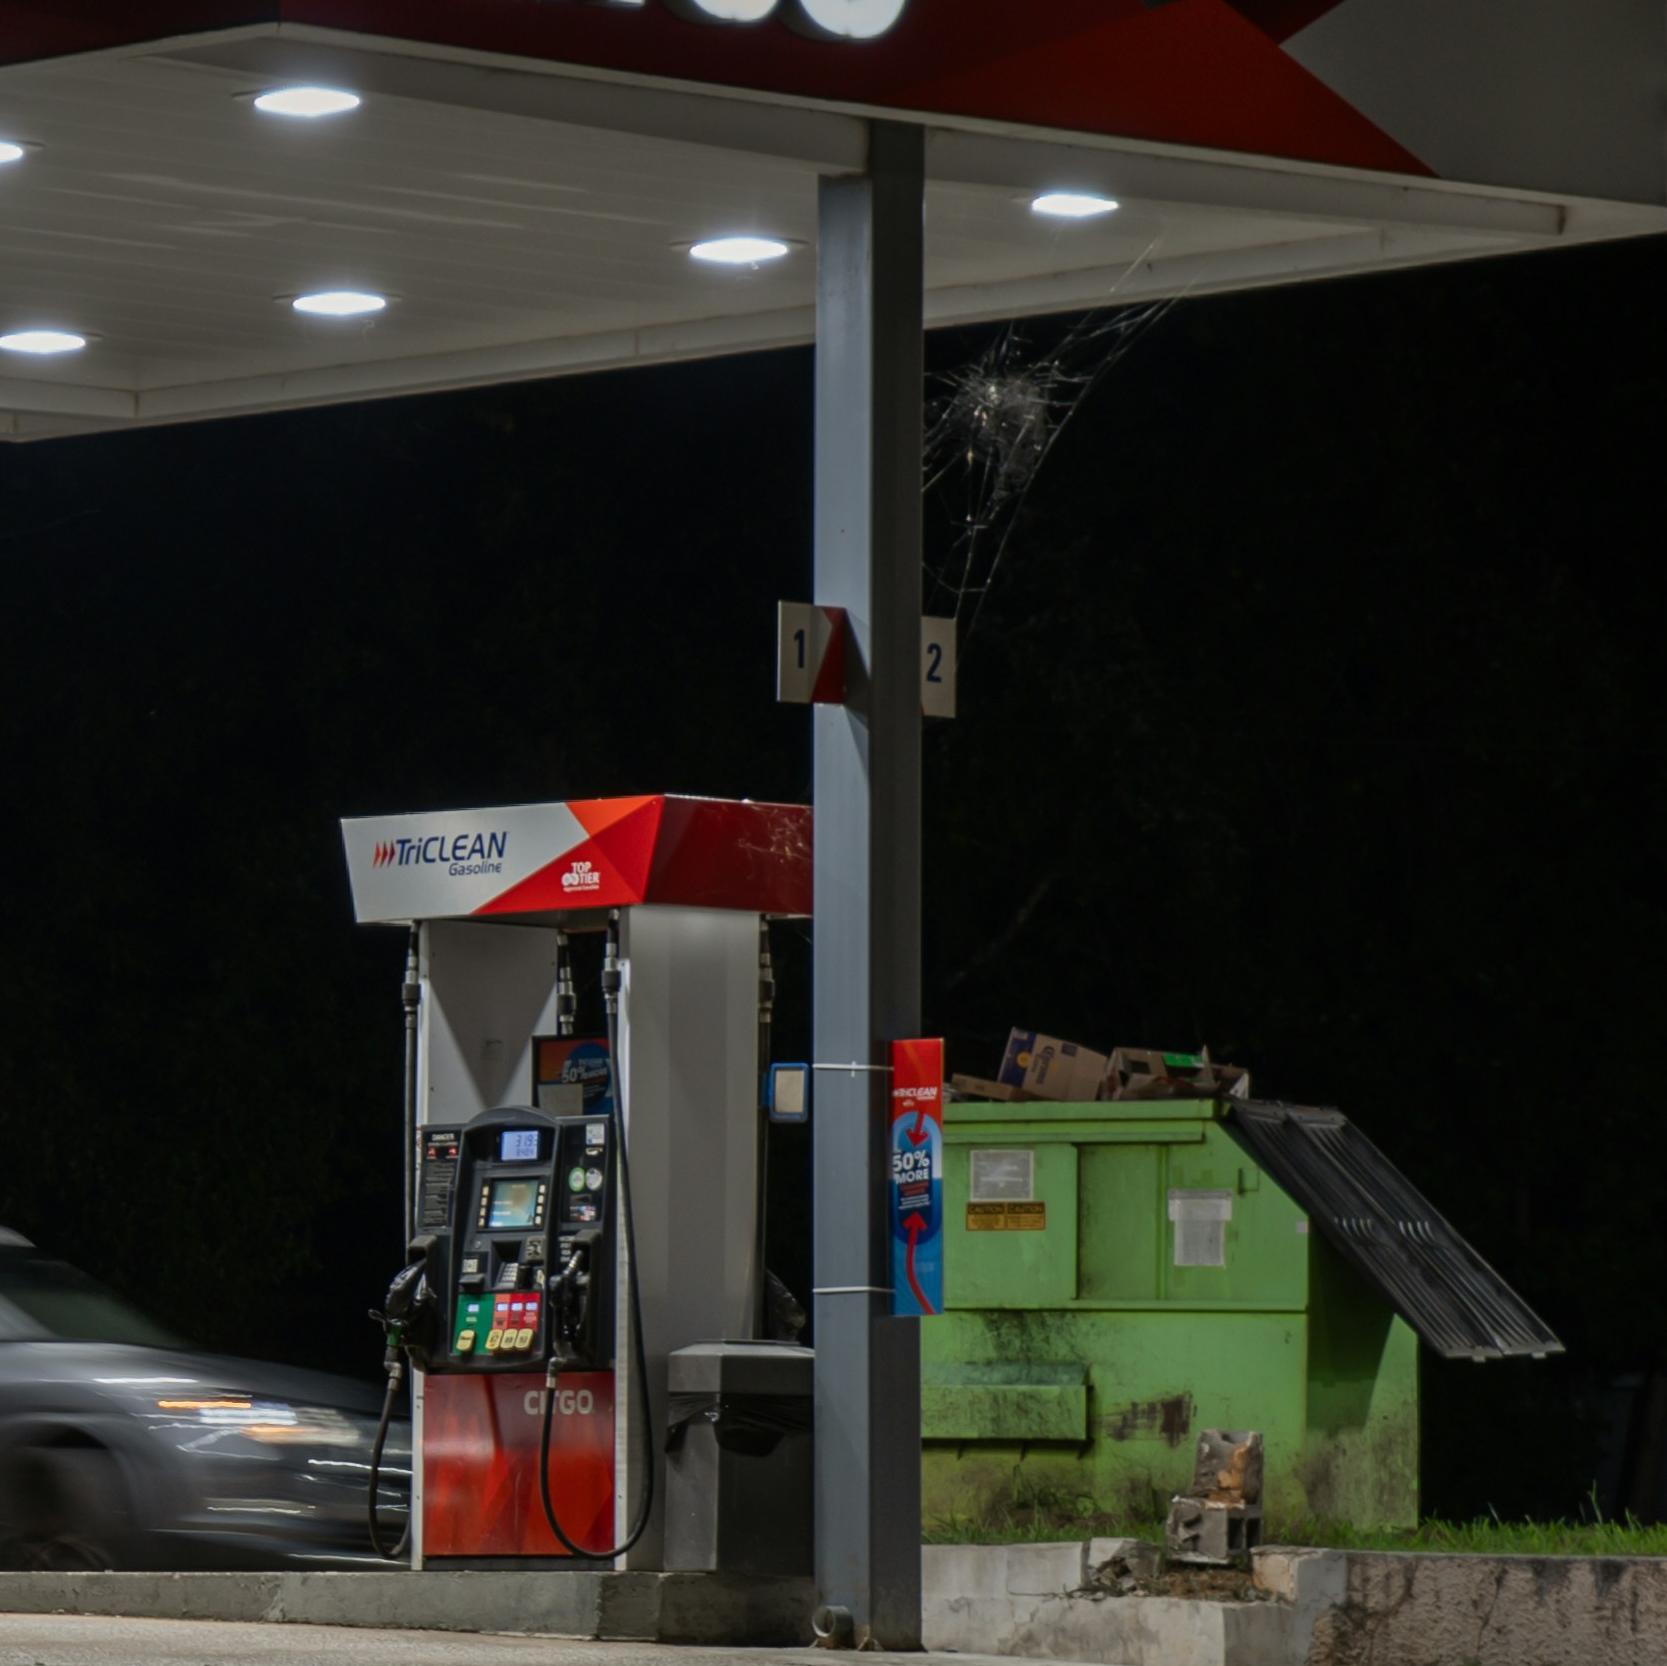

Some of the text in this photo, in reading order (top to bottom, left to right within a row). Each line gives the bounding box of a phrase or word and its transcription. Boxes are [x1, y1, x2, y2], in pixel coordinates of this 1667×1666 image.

[794, 629, 804, 668] 1
[926, 643, 942, 683] 2
[396, 832, 507, 866] TriCLEAN
[448, 861, 502, 876] Gasoline
[570, 861, 592, 873] TOP
[579, 871, 600, 884] TIER
[892, 1150, 930, 1173] 50%
[894, 1168, 930, 1184] MORE
